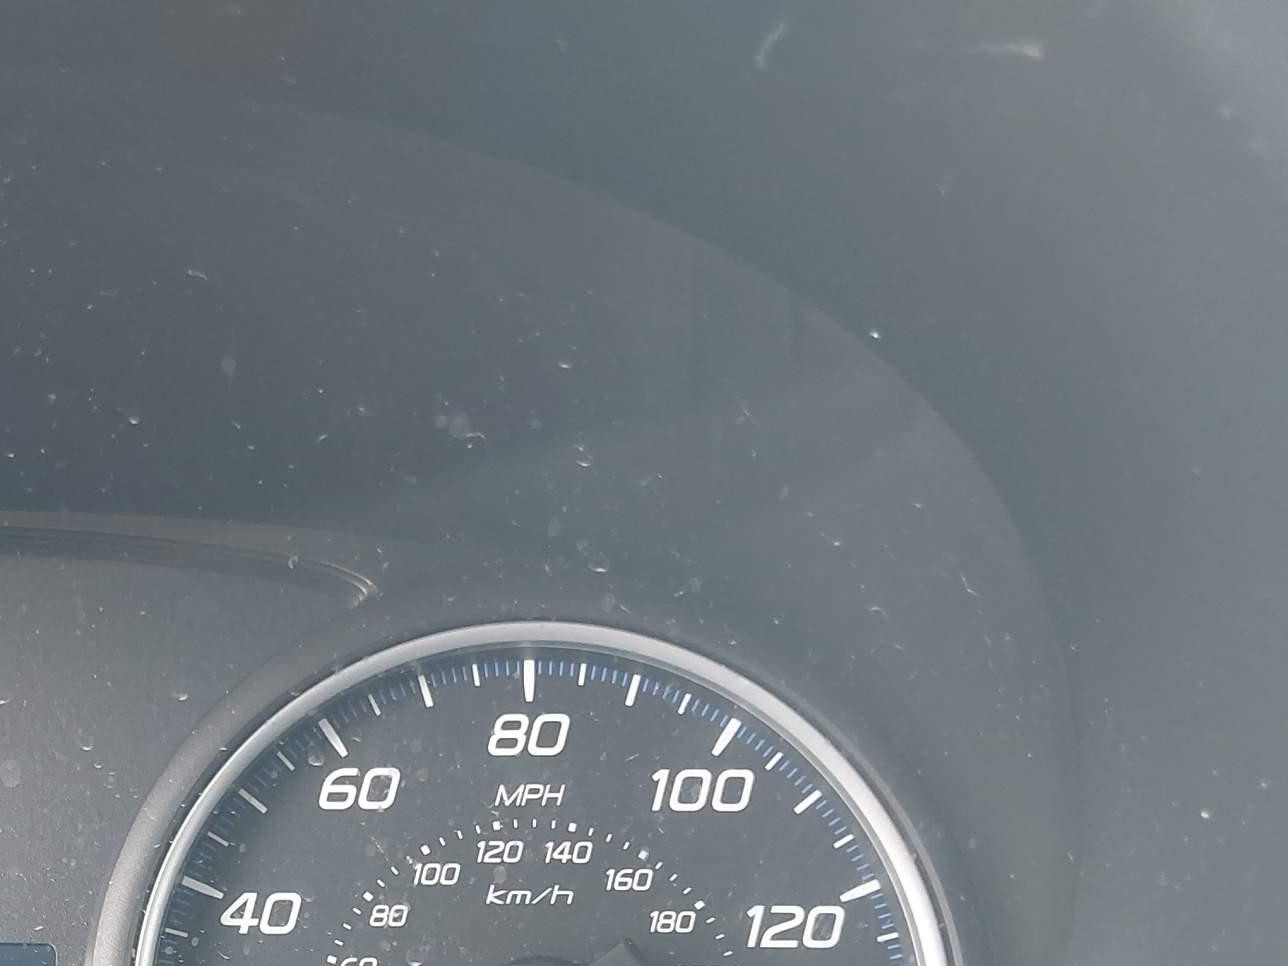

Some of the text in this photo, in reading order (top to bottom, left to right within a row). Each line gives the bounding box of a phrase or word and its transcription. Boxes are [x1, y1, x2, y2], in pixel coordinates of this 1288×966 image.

[487, 713, 570, 757] 80
[318, 768, 401, 812] 60
[494, 784, 565, 807] MPH
[651, 768, 754, 813] 100
[476, 840, 524, 864] 120
[543, 840, 593, 864] 140
[412, 863, 461, 887] 100
[605, 868, 653, 892] 160
[485, 884, 574, 906] km/h
[220, 893, 302, 935] 40
[368, 904, 408, 928] 80
[649, 910, 696, 934] 180
[745, 905, 845, 949] 120
